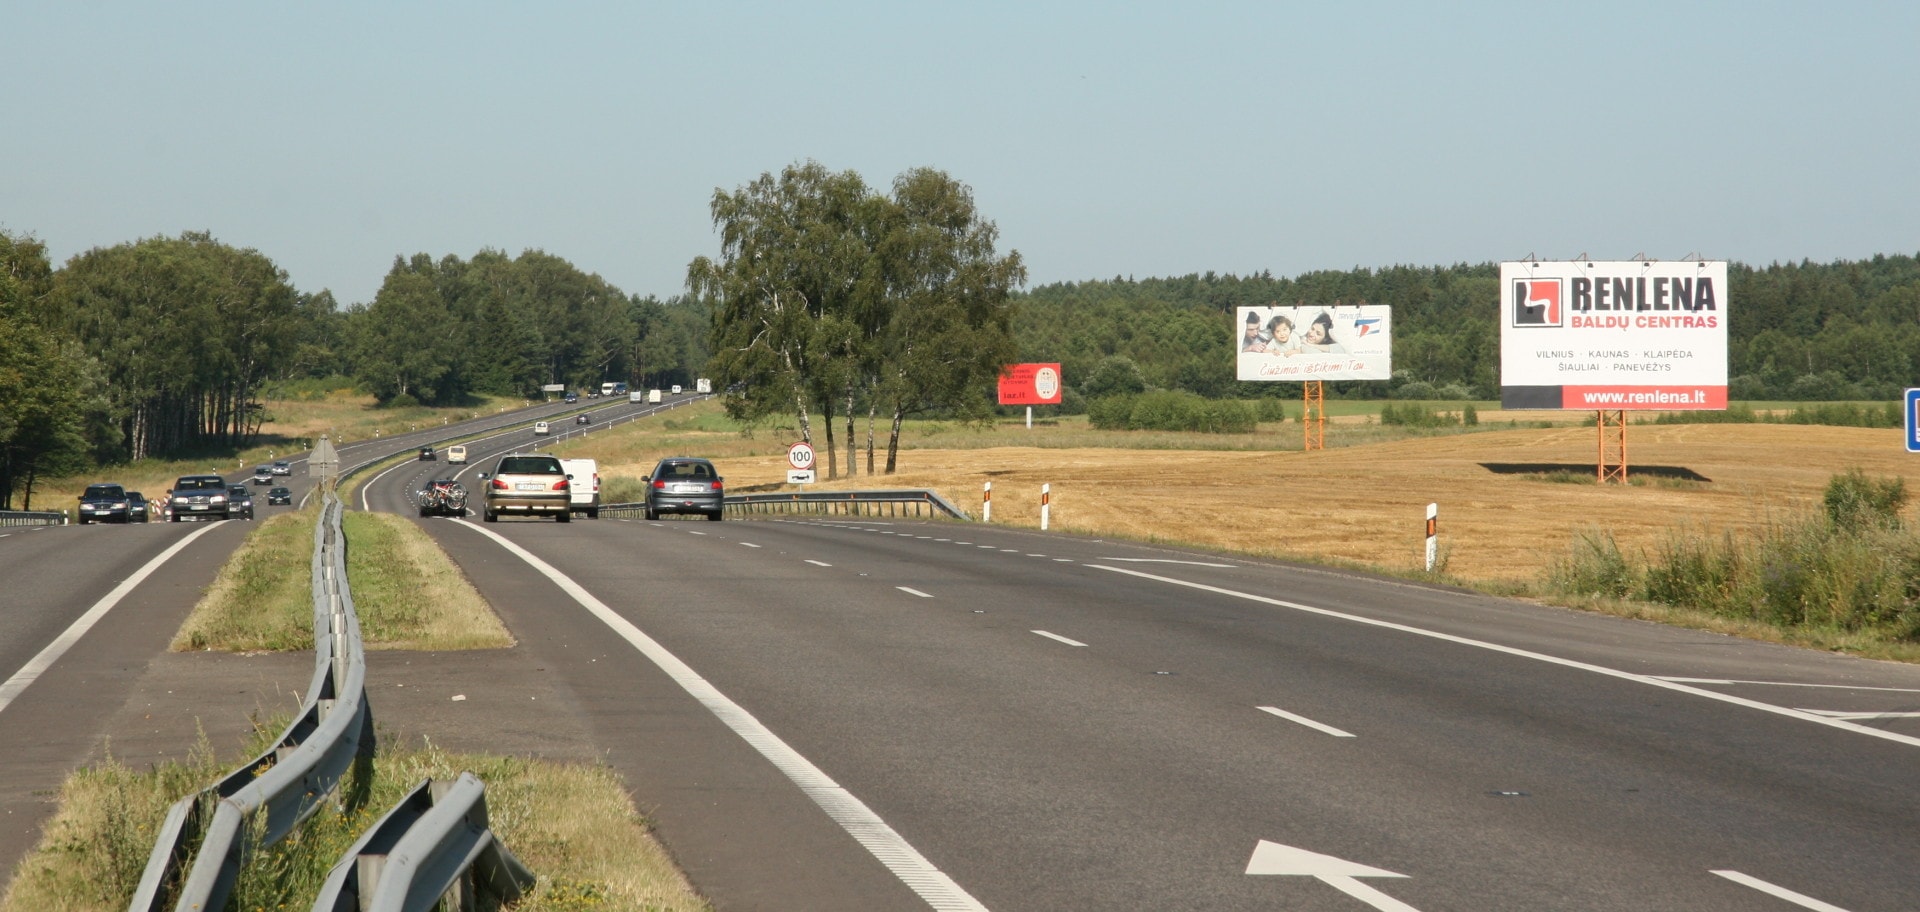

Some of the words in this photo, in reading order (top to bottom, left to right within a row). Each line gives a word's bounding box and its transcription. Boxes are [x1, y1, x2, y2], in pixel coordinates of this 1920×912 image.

[1571, 277, 1717, 311] RENLENA
[1571, 316, 1629, 331] BALDŲ
[1635, 316, 1718, 328] CENTRAS
[1536, 350, 1574, 358] VILNIUS
[1588, 350, 1630, 358] KAUNAS
[1643, 348, 1693, 358] KLAIPĖDA
[1558, 361, 1600, 371] ŠIAULIAI
[1584, 390, 1705, 403] www.renlena.lt
[792, 451, 811, 462] 100
